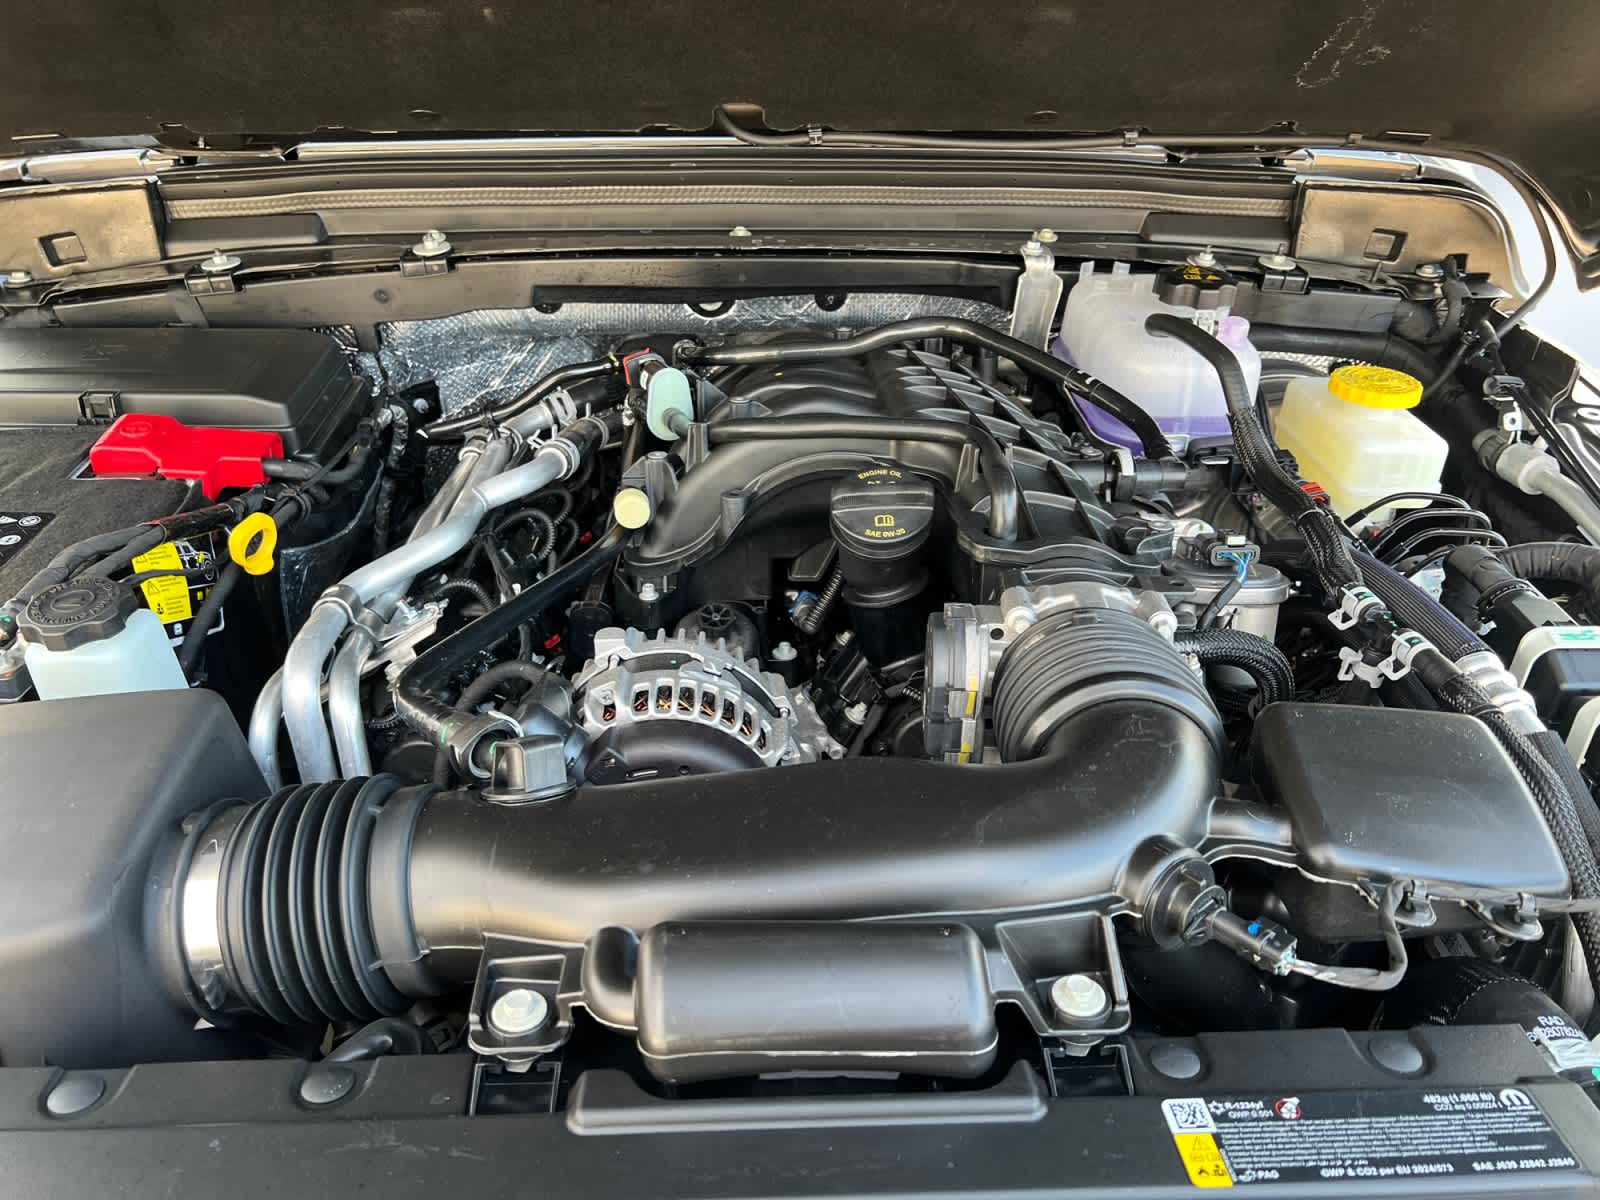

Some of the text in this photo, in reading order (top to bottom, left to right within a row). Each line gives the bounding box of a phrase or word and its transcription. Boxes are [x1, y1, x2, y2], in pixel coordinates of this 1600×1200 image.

[857, 469, 903, 480] ENGINE OIL
[864, 529, 882, 538] SAE
[1537, 1015, 1565, 1026] RAD
